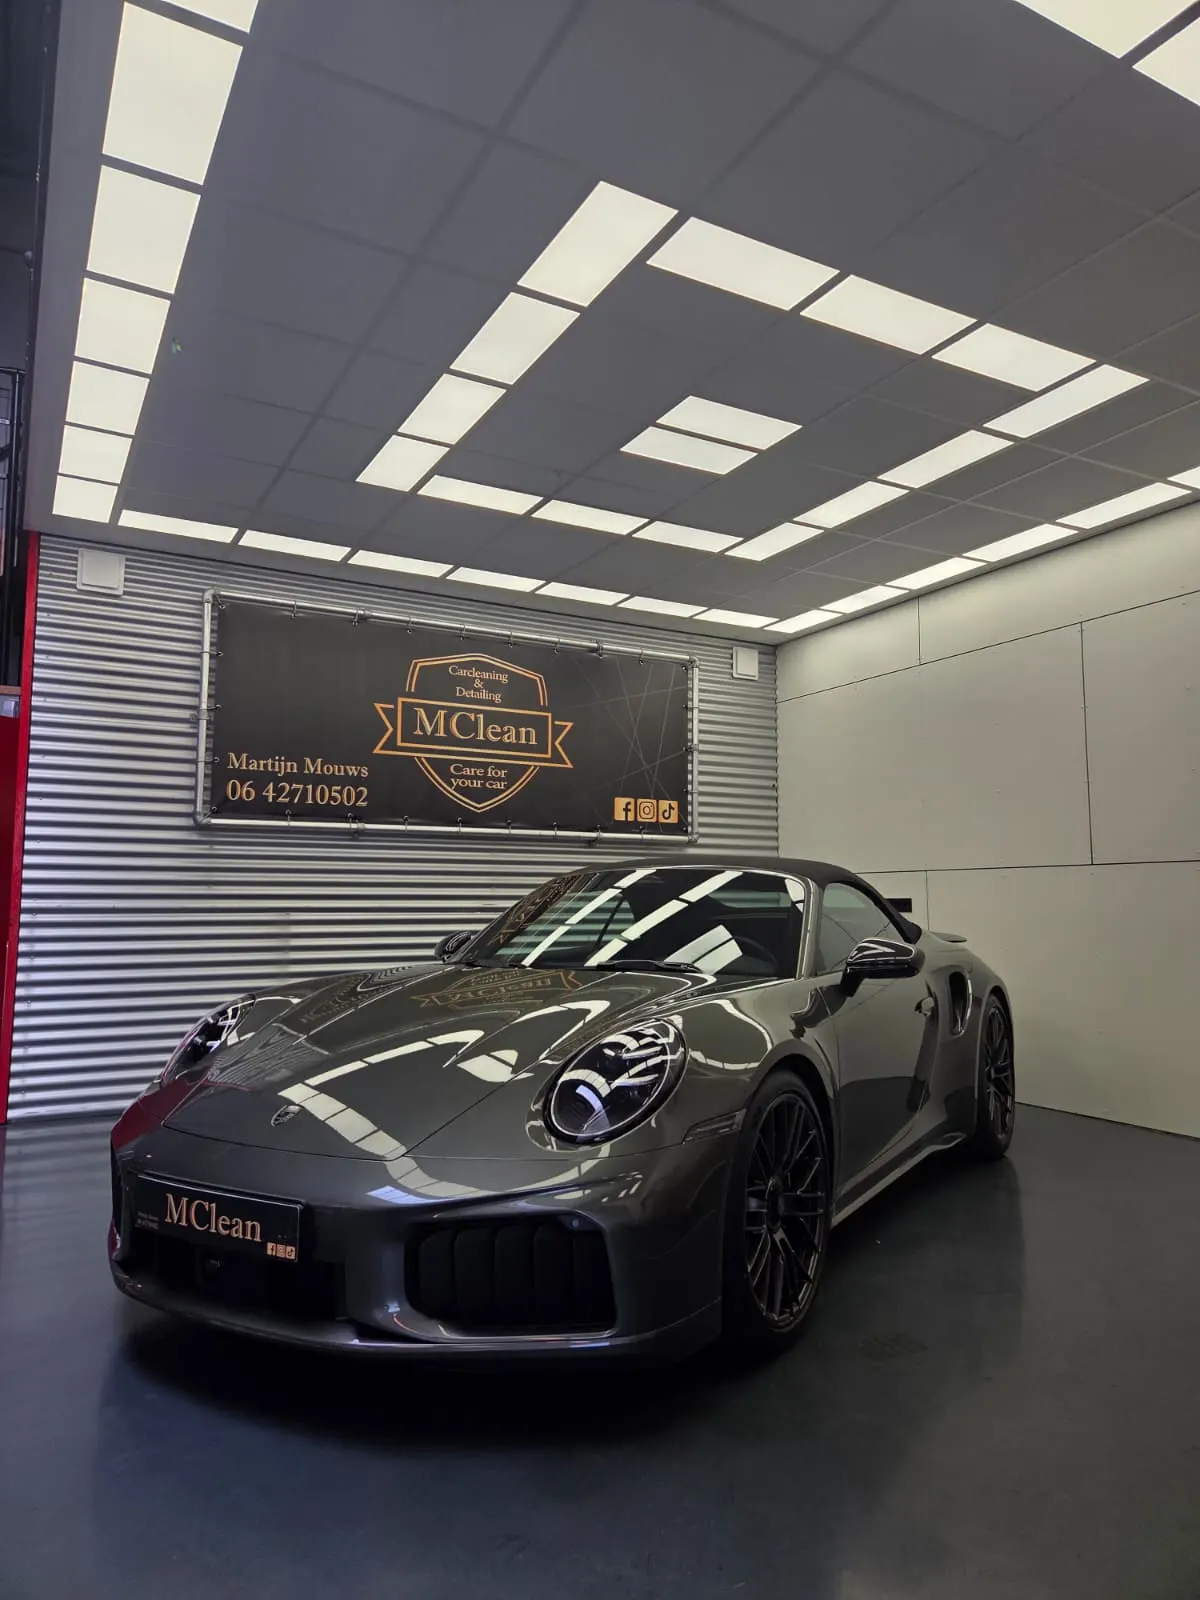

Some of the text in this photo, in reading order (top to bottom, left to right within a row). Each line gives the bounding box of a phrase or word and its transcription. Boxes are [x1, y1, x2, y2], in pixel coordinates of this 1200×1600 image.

[448, 665, 508, 684] Carcleaning
[473, 678, 484, 689] &
[456, 686, 502, 704] Detailing
[413, 707, 538, 745] MClean
[227, 752, 369, 777] Martijn Mouws
[449, 763, 508, 778] Care for
[226, 779, 369, 807] 06 42710502
[451, 778, 508, 791] your car
[164, 1192, 262, 1243] MClean
